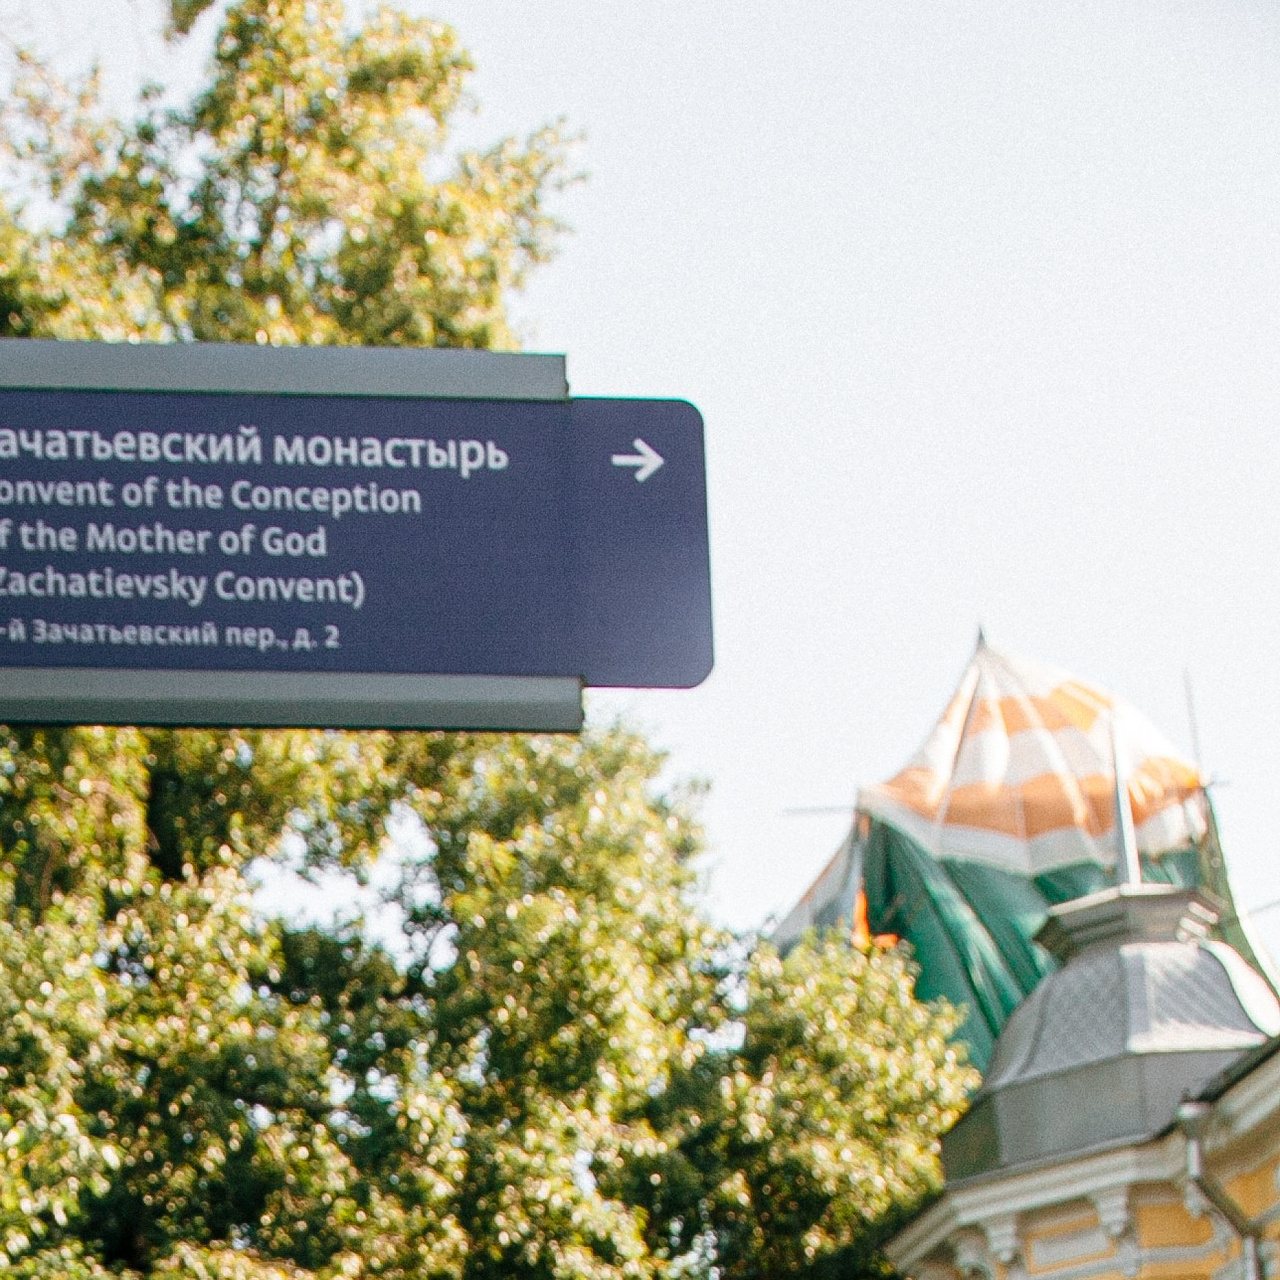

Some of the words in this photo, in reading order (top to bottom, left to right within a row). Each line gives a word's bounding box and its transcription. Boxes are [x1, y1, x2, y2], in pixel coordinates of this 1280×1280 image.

[273, 435, 509, 479] монастырь
[122, 476, 159, 507] of
[165, 477, 224, 509] the
[231, 480, 422, 519] Conception
[19, 520, 78, 551] the
[86, 523, 212, 554] Mother
[219, 523, 256, 555] of
[261, 526, 327, 557] God
[215, 571, 365, 609] Convent)
[33, 617, 219, 645] Зачатьевский
[292, 628, 318, 651] д.
[324, 625, 339, 648] 2
